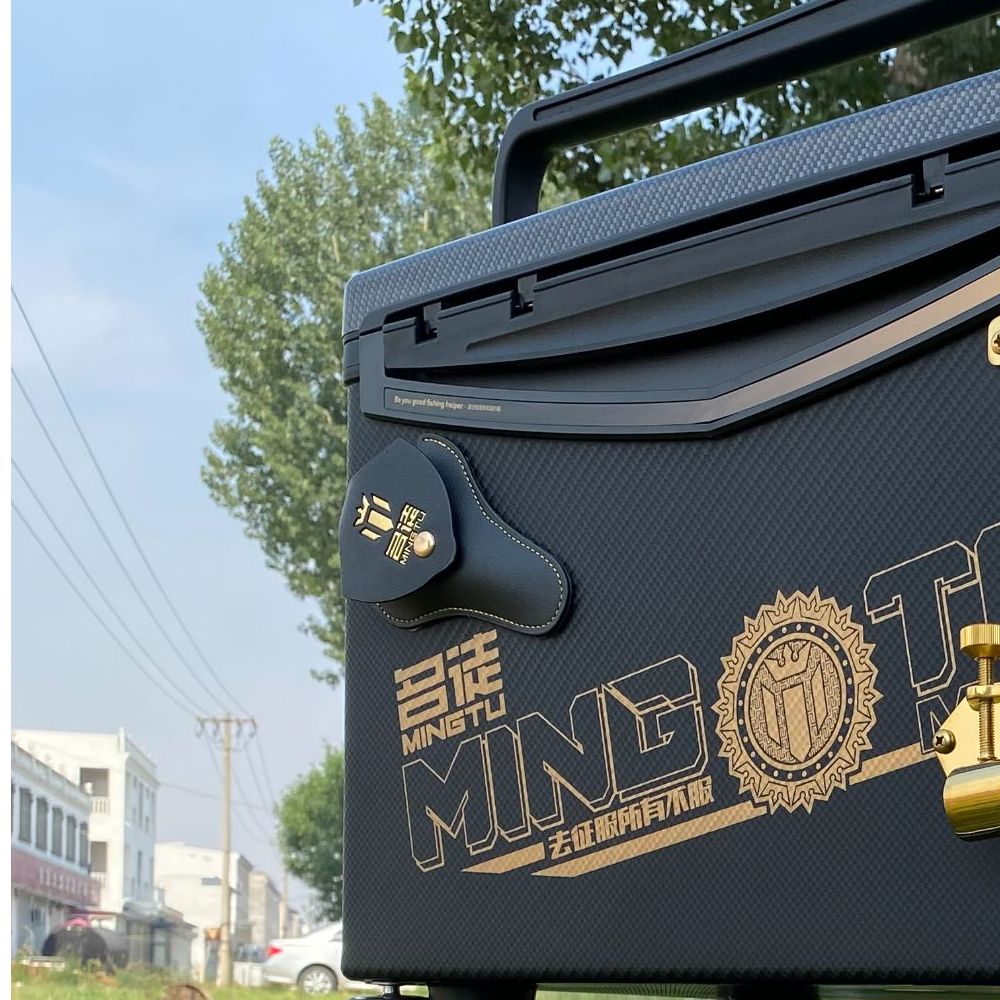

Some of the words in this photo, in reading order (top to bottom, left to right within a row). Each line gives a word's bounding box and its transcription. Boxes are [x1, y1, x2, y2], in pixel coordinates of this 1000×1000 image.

[411, 398, 427, 407] good
[427, 398, 445, 409] fishing
[445, 400, 463, 411] helper
[402, 693, 506, 755] MINGTU
[402, 655, 708, 872] MING
